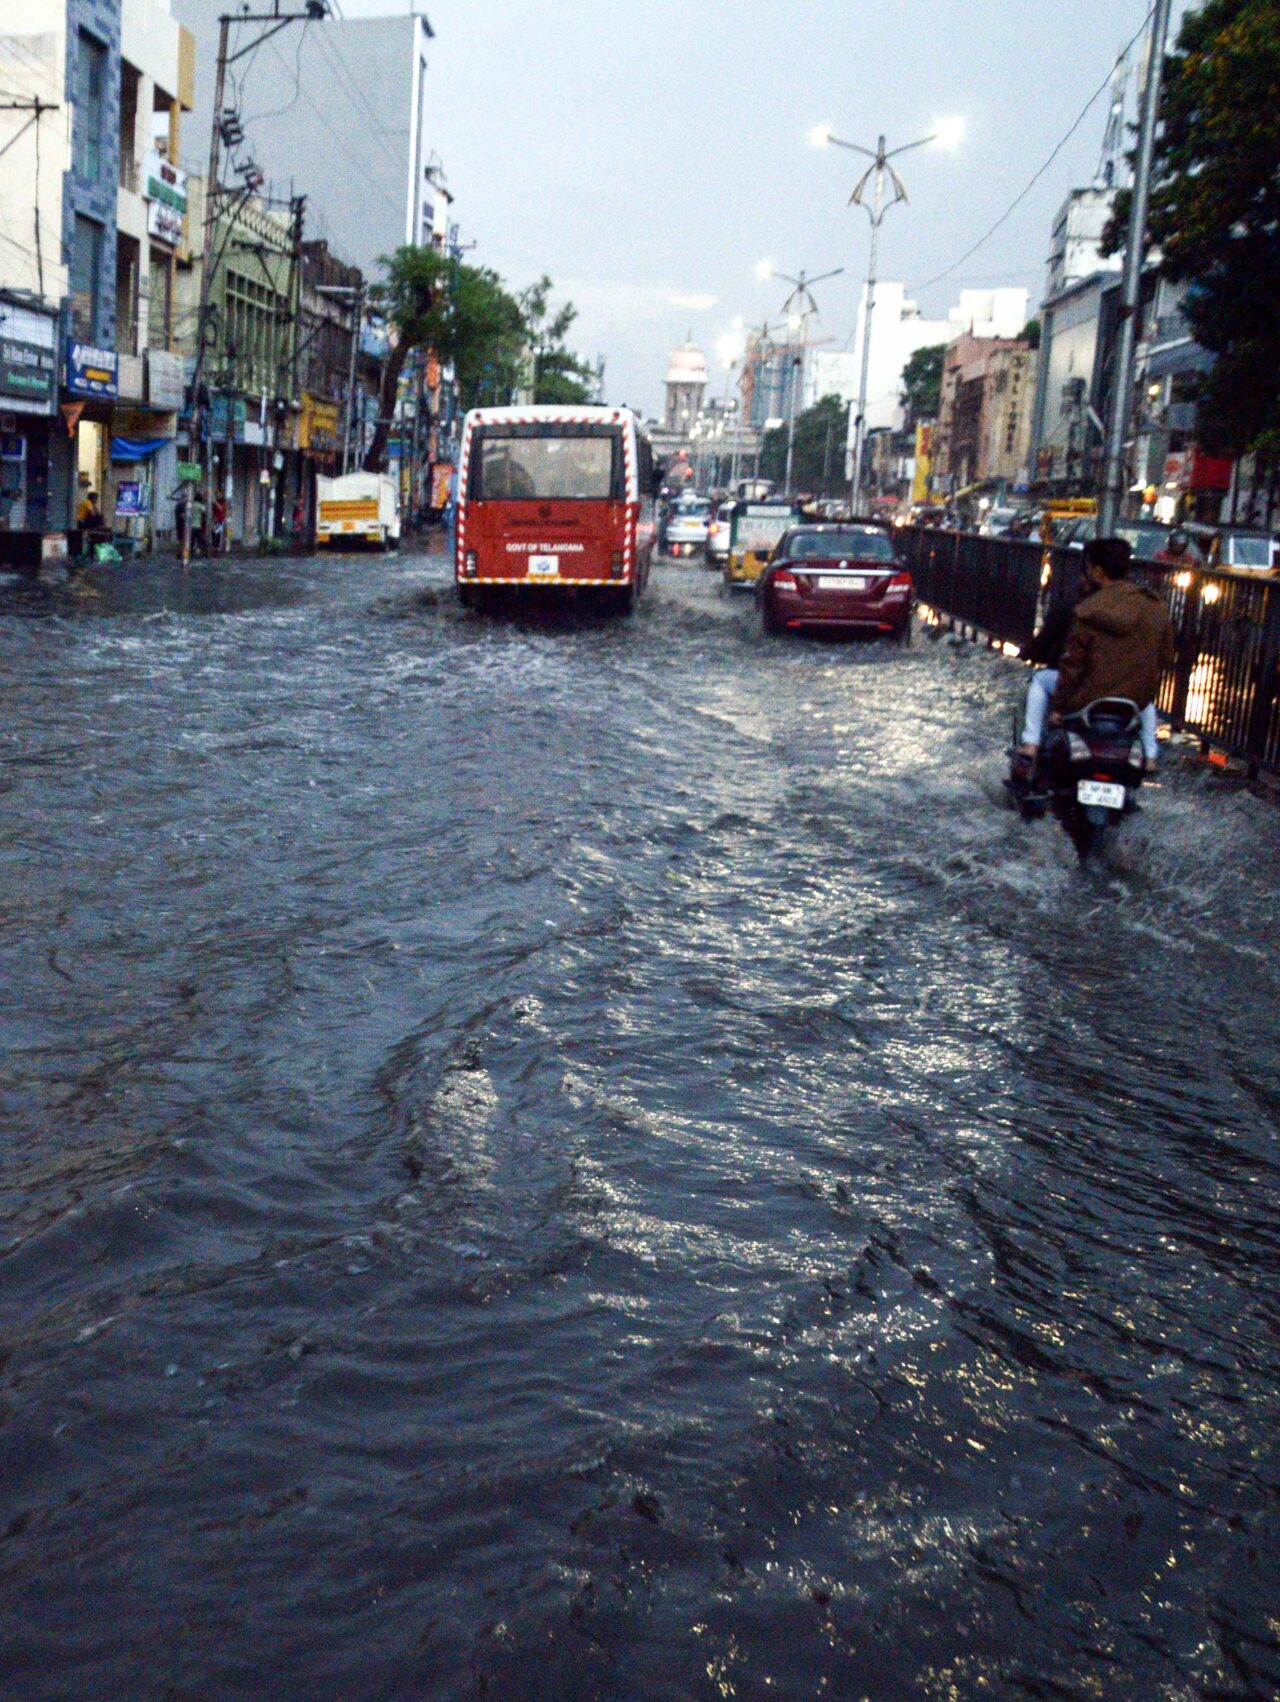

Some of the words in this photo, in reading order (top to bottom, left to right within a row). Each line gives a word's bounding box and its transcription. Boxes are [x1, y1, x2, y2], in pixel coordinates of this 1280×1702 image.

[505, 543, 527, 553] GOVT
[527, 543, 538, 553] OF
[539, 543, 584, 552] TELANGANA
